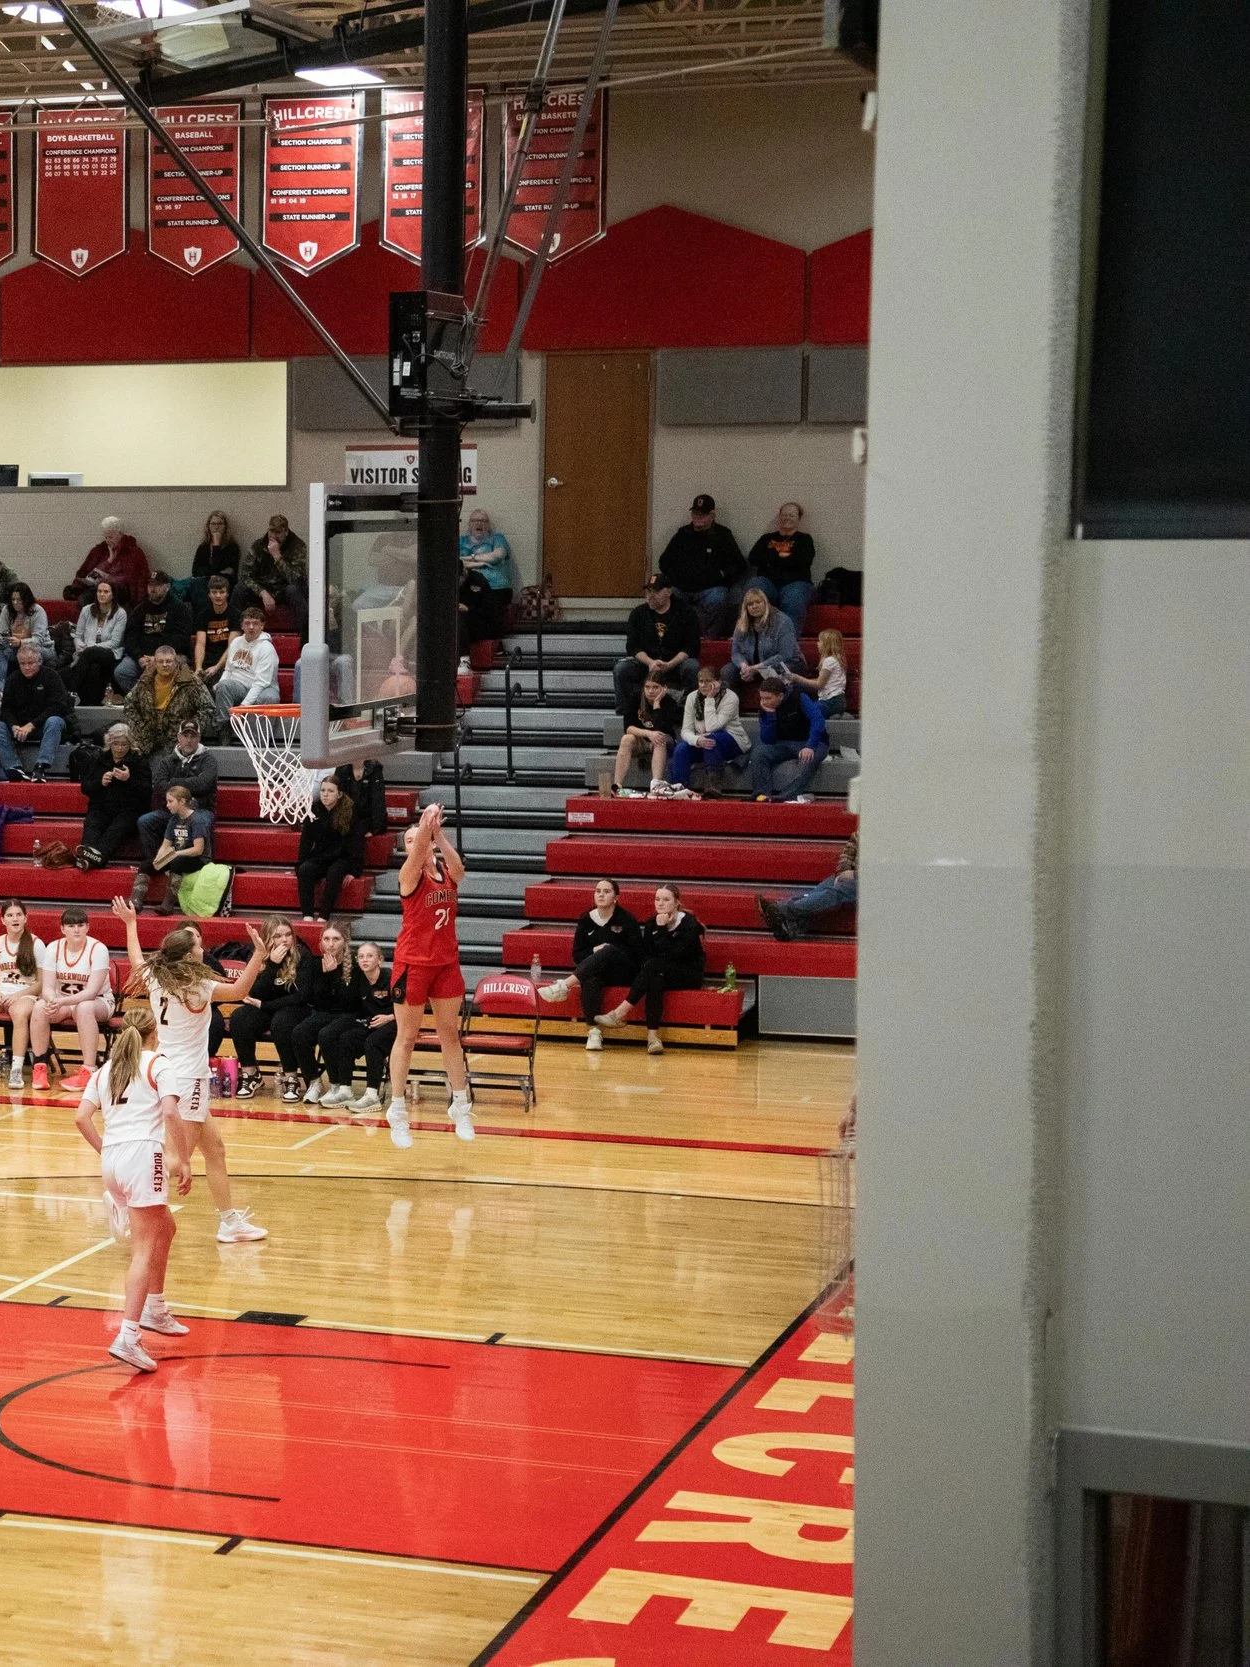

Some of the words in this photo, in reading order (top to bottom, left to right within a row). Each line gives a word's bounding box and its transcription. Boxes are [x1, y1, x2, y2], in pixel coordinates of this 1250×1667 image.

[274, 106, 350, 121] HILLCREST
[68, 134, 114, 142] BASKETBALL
[175, 131, 214, 139] BASEBALL
[307, 138, 342, 146] CHAMPIONS
[350, 467, 407, 484] VISITOR
[61, 984, 84, 994] 23
[482, 983, 531, 996] HILLCREST
[160, 996, 168, 1026] 2
[154, 1152, 162, 1192] ROCKETS
